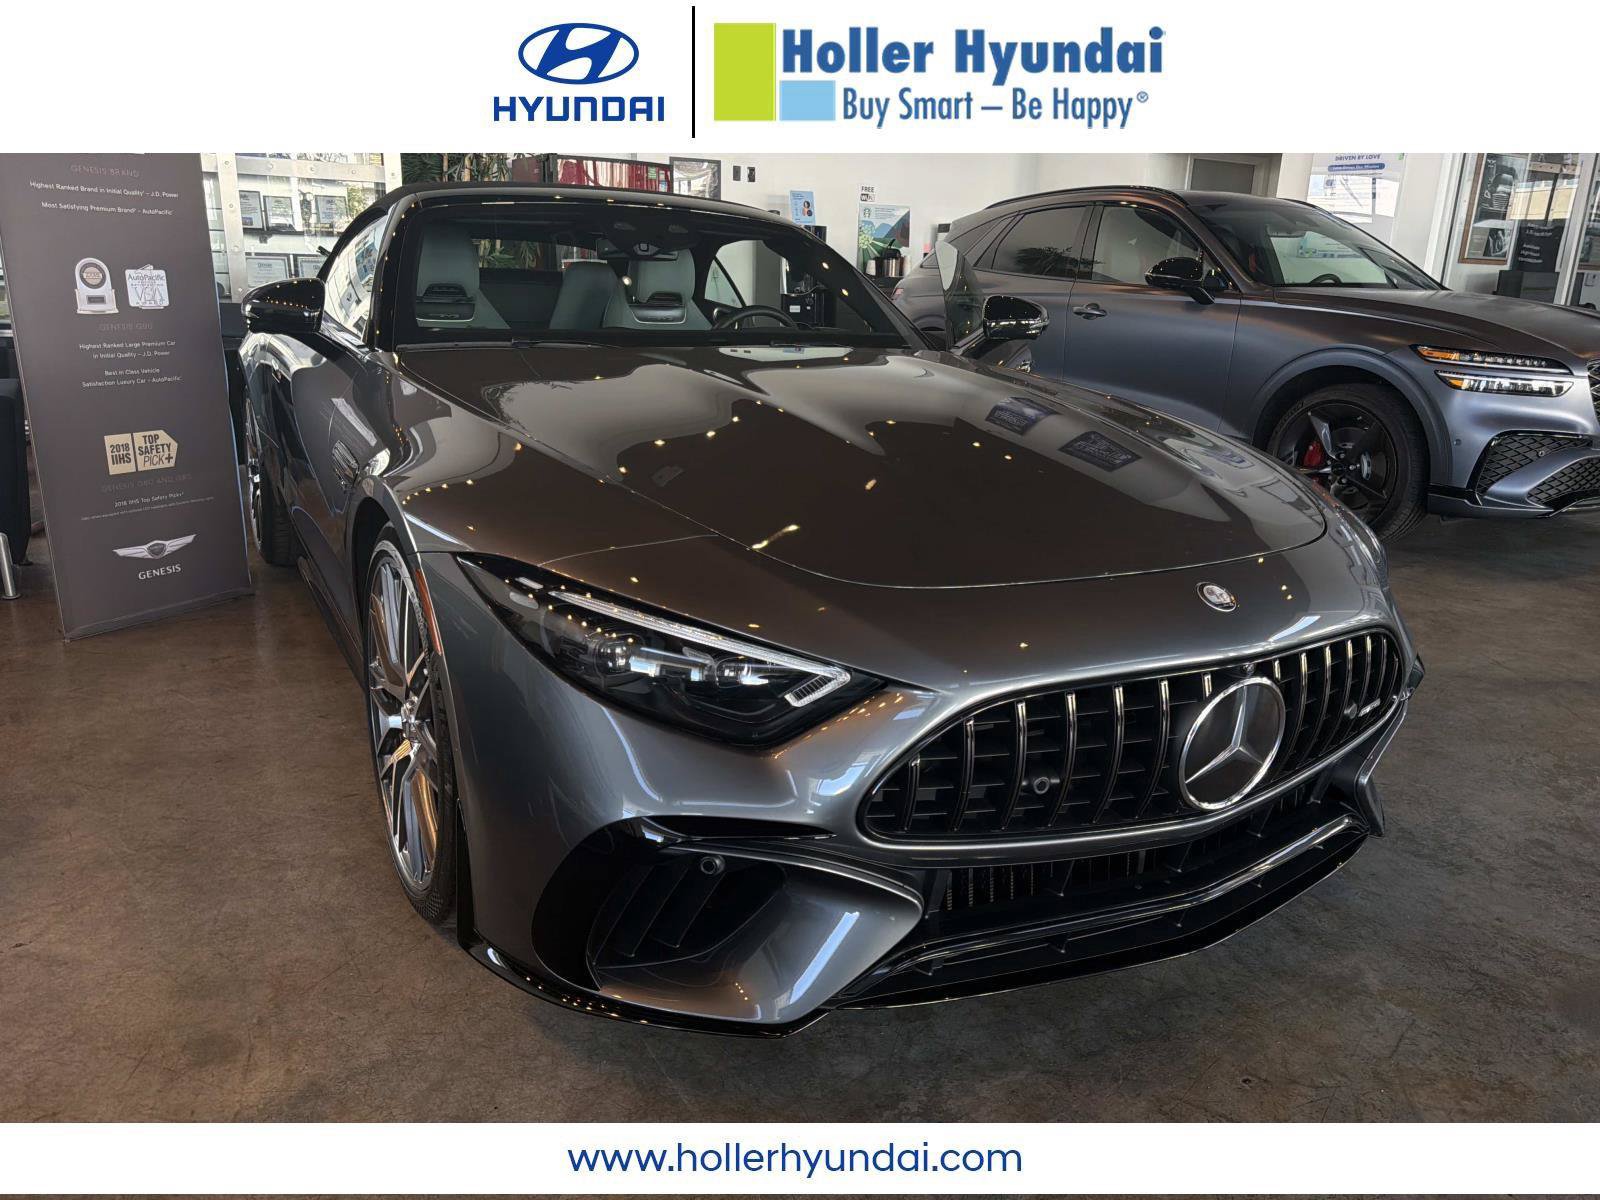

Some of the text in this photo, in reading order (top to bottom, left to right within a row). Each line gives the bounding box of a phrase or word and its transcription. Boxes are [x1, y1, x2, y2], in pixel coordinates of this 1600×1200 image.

[1334, 154, 1356, 162] DRIVEN
[29, 181, 55, 190] Highest
[56, 183, 79, 192] Ranked
[80, 185, 98, 193] Brand
[860, 185, 875, 193] FREE
[41, 201, 58, 209] Most
[59, 203, 89, 212] Satisfying
[90, 205, 117, 213] Premium
[142, 434, 160, 446] TOP
[109, 442, 131, 454] 2018
[137, 442, 172, 457] SAFETY
[110, 452, 132, 466] IIHS
[138, 563, 182, 580] GENESIS
